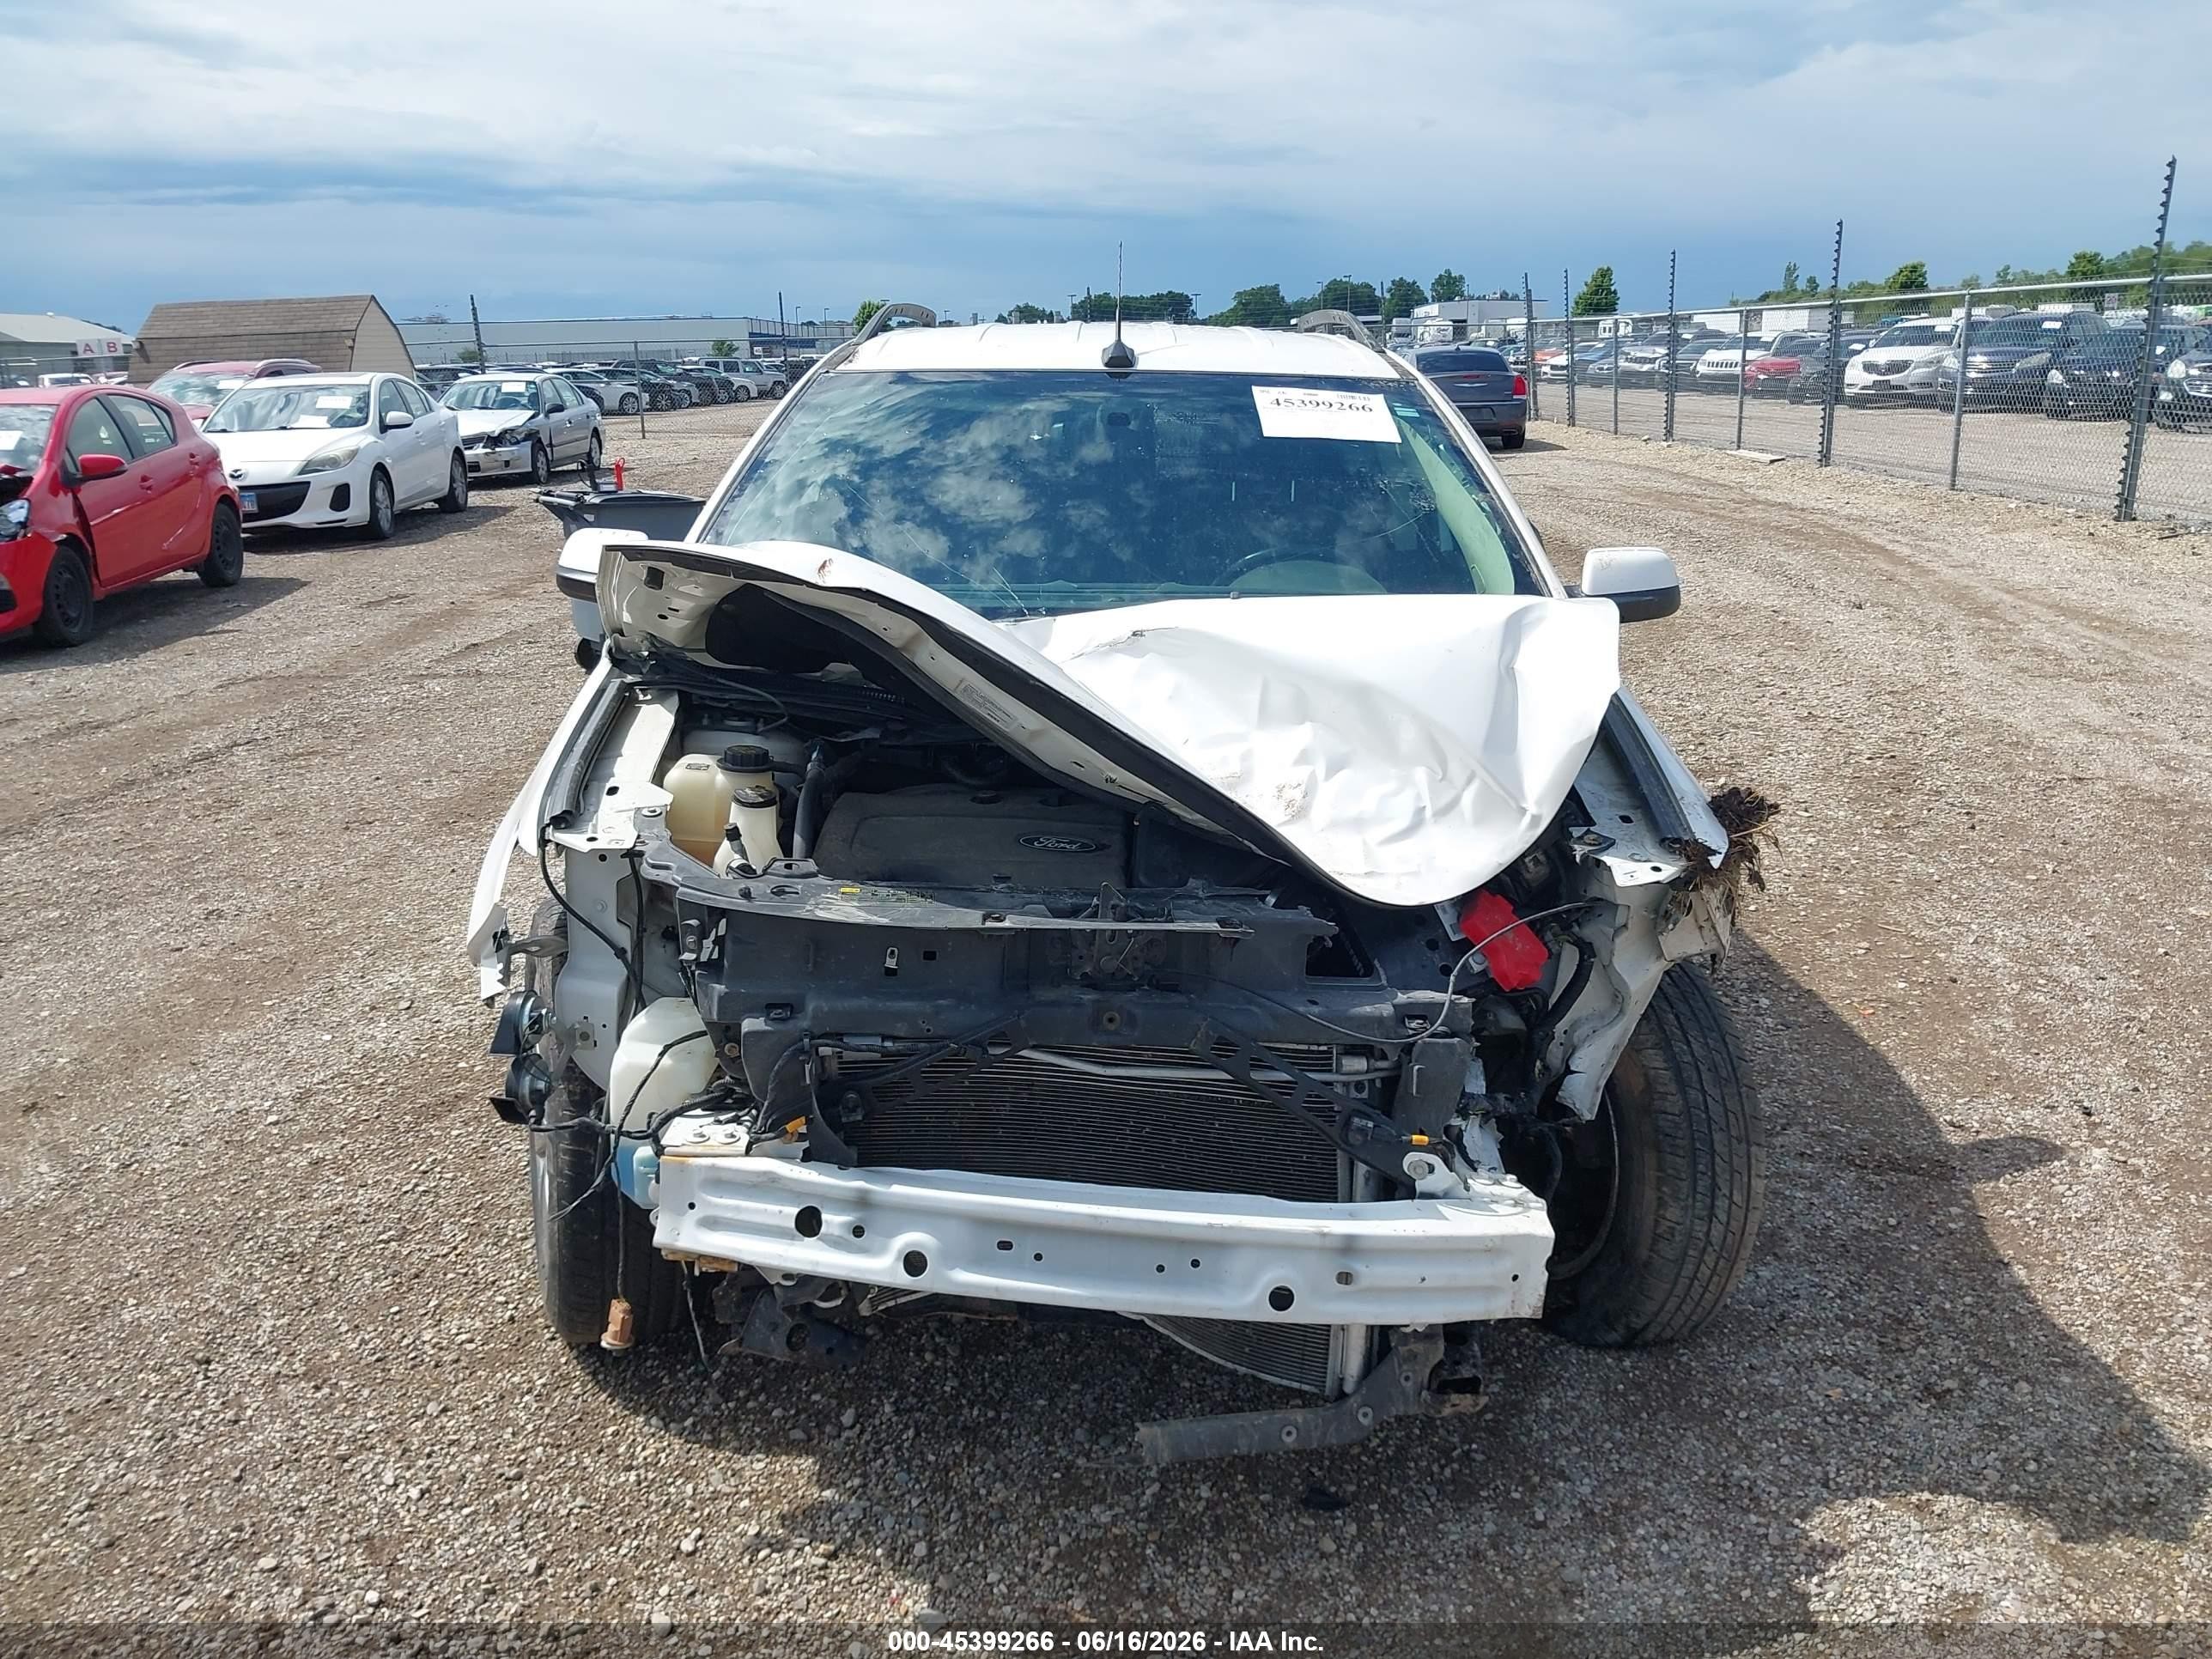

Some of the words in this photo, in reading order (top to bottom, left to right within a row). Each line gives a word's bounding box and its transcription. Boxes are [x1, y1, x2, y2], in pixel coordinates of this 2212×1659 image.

[83, 343, 94, 354] A
[107, 342, 118, 353] B
[1270, 398, 1373, 413] 45399266
[1033, 836, 1082, 850] Ford
